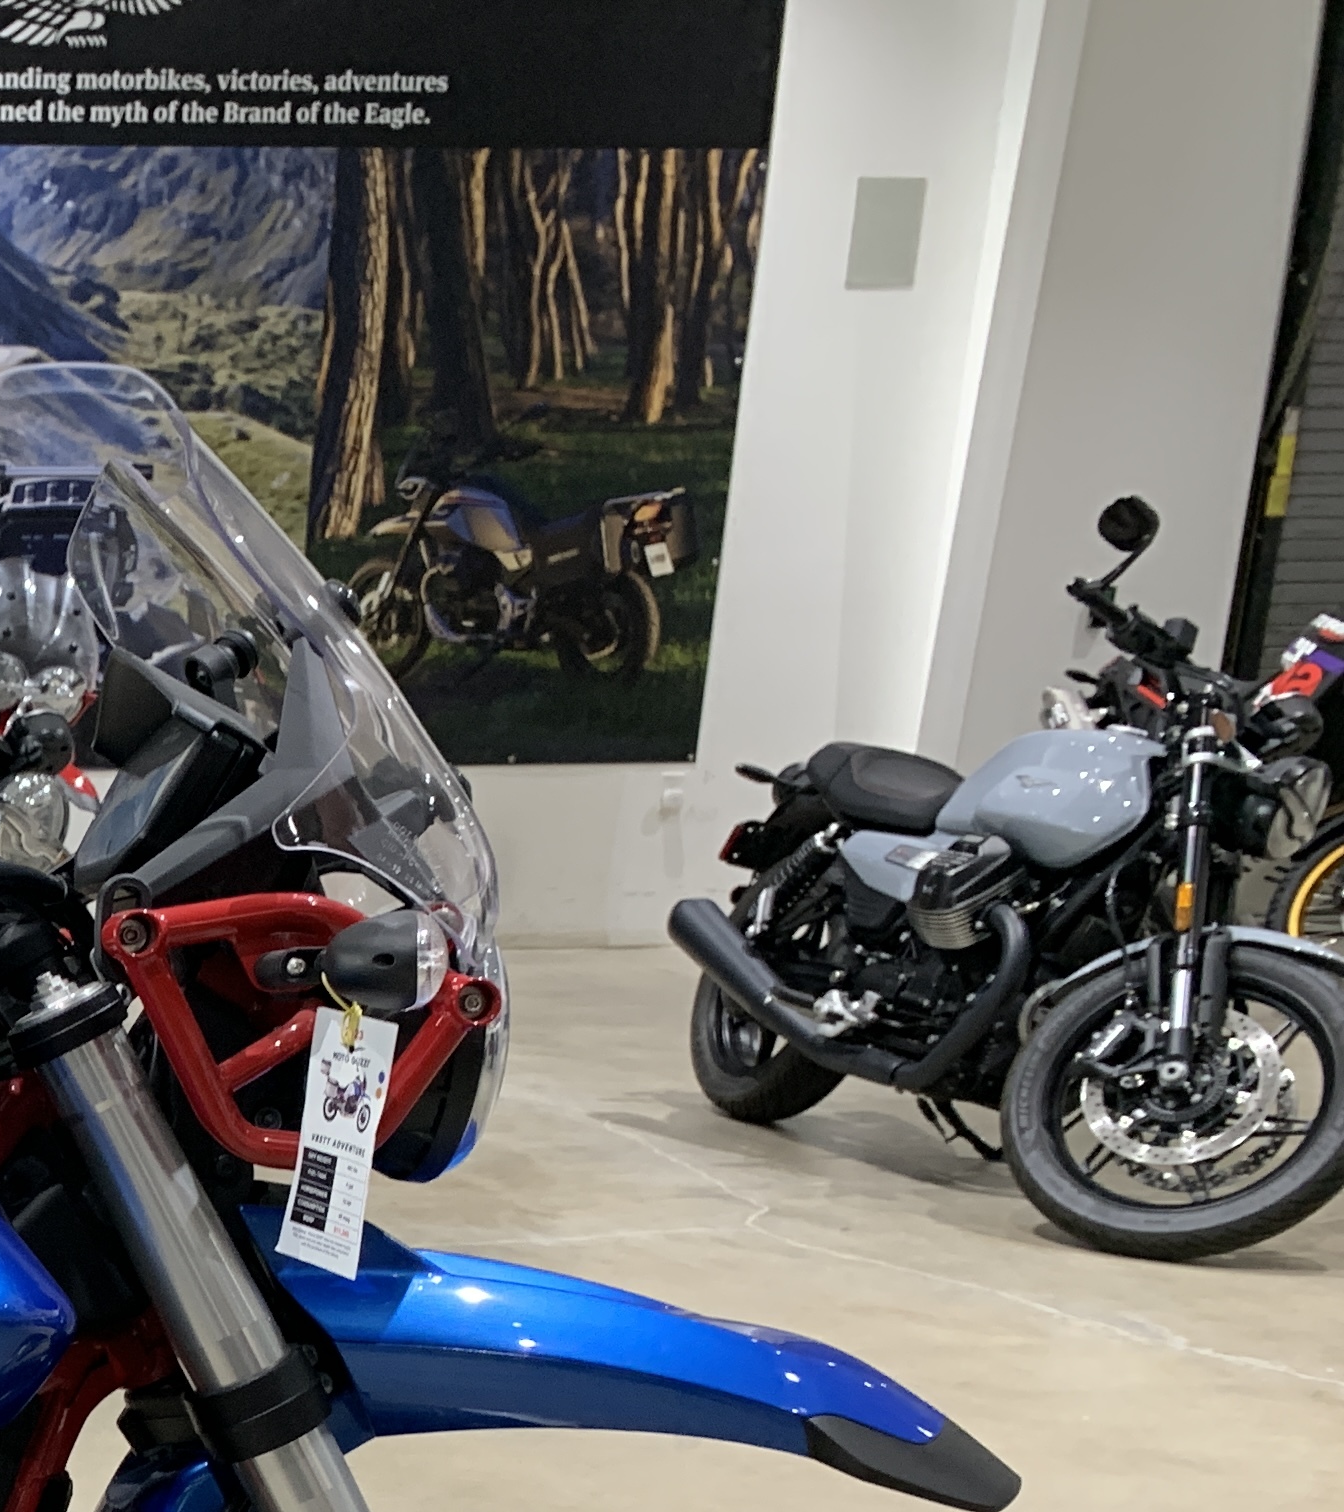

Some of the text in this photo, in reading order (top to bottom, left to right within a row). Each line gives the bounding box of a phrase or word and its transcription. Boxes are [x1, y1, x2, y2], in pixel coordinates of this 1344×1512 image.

[75, 67, 212, 94] motorbikes,
[216, 68, 319, 95] victories,
[323, 69, 449, 93] adventures
[47, 99, 85, 124] the
[89, 100, 149, 128] myth
[152, 100, 180, 124] of
[181, 101, 219, 124] the
[223, 102, 292, 125] Brand
[296, 101, 322, 125] of
[323, 102, 361, 125] the
[364, 102, 431, 130] Eagle.
[332, 1138, 366, 1159] ADVENTURE
